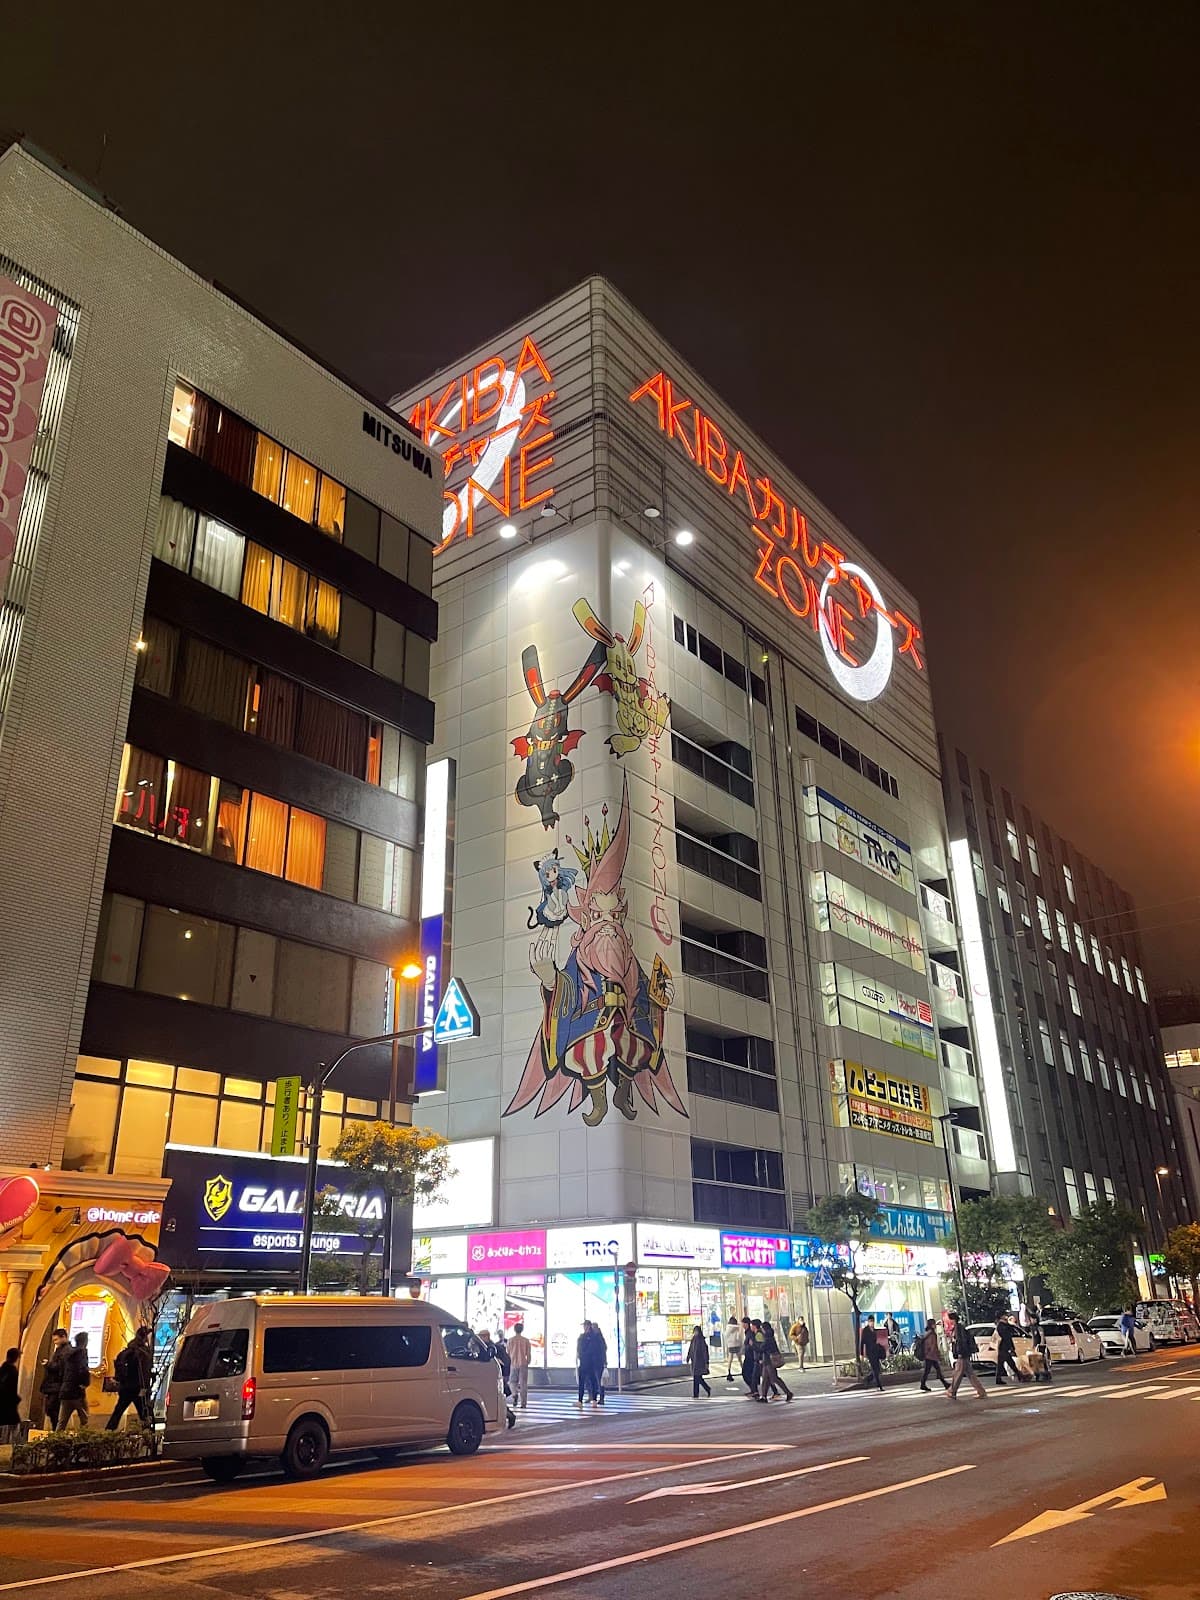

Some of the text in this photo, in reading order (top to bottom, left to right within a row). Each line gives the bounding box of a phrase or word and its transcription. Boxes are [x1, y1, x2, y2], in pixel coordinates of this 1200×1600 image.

[362, 411, 433, 479] MITSUWA
[751, 524, 859, 667] ZONE
[868, 915, 898, 944] home
[87, 1207, 161, 1224] @home cafe
[253, 1233, 341, 1251] esports lunge
